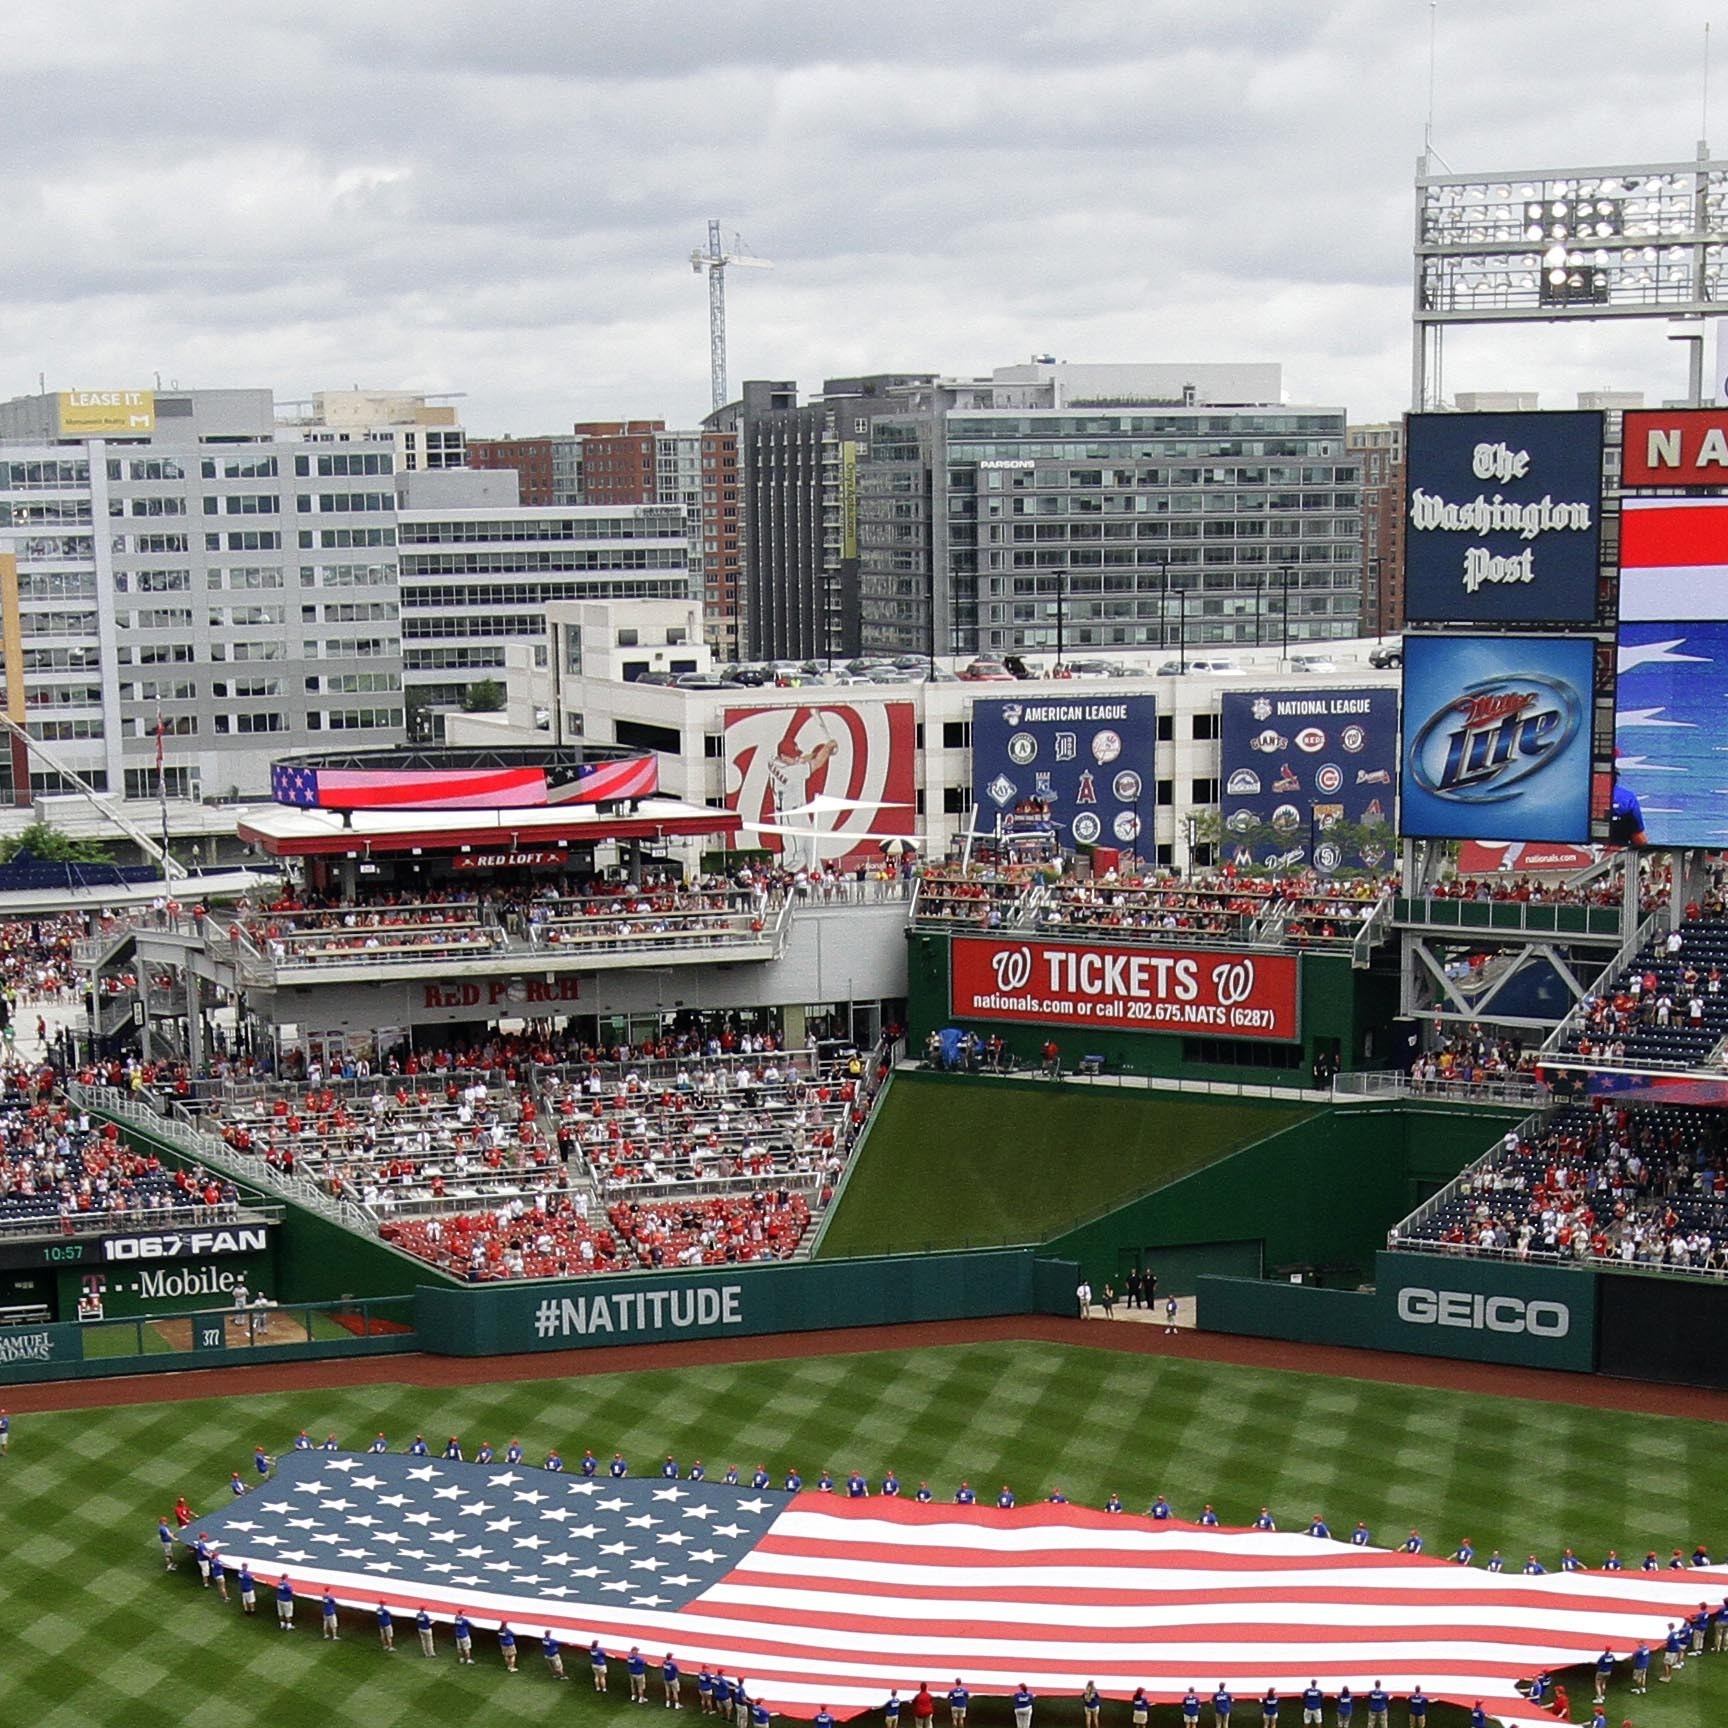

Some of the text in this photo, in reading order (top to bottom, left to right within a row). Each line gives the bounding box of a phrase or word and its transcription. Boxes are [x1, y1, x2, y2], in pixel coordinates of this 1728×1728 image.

[70, 393, 120, 406] LEASE
[980, 460, 1035, 469] PARSONS
[1472, 442, 1530, 483] The
[1411, 488, 1592, 540] Washington
[1462, 547, 1536, 593] Post
[1025, 704, 1128, 722] AMERICAN LEAGUE
[1277, 698, 1371, 716] NATIONAL LEAGUE
[477, 853, 544, 867] RED LOFT
[1524, 853, 1578, 864] nationals.com
[1043, 951, 1199, 1001] TICKETS
[424, 982, 481, 1009] RED
[973, 992, 1276, 1030] nationals.com or call 202.675.NATS (6287)
[43, 1245, 84, 1262] 10:57
[104, 1229, 267, 1260] 106.7 FAN
[139, 1265, 235, 1299] Mobile
[535, 1285, 743, 1338] #NATITUDE
[1397, 1287, 1570, 1338] GEICO
[202, 1328, 220, 1346] 377
